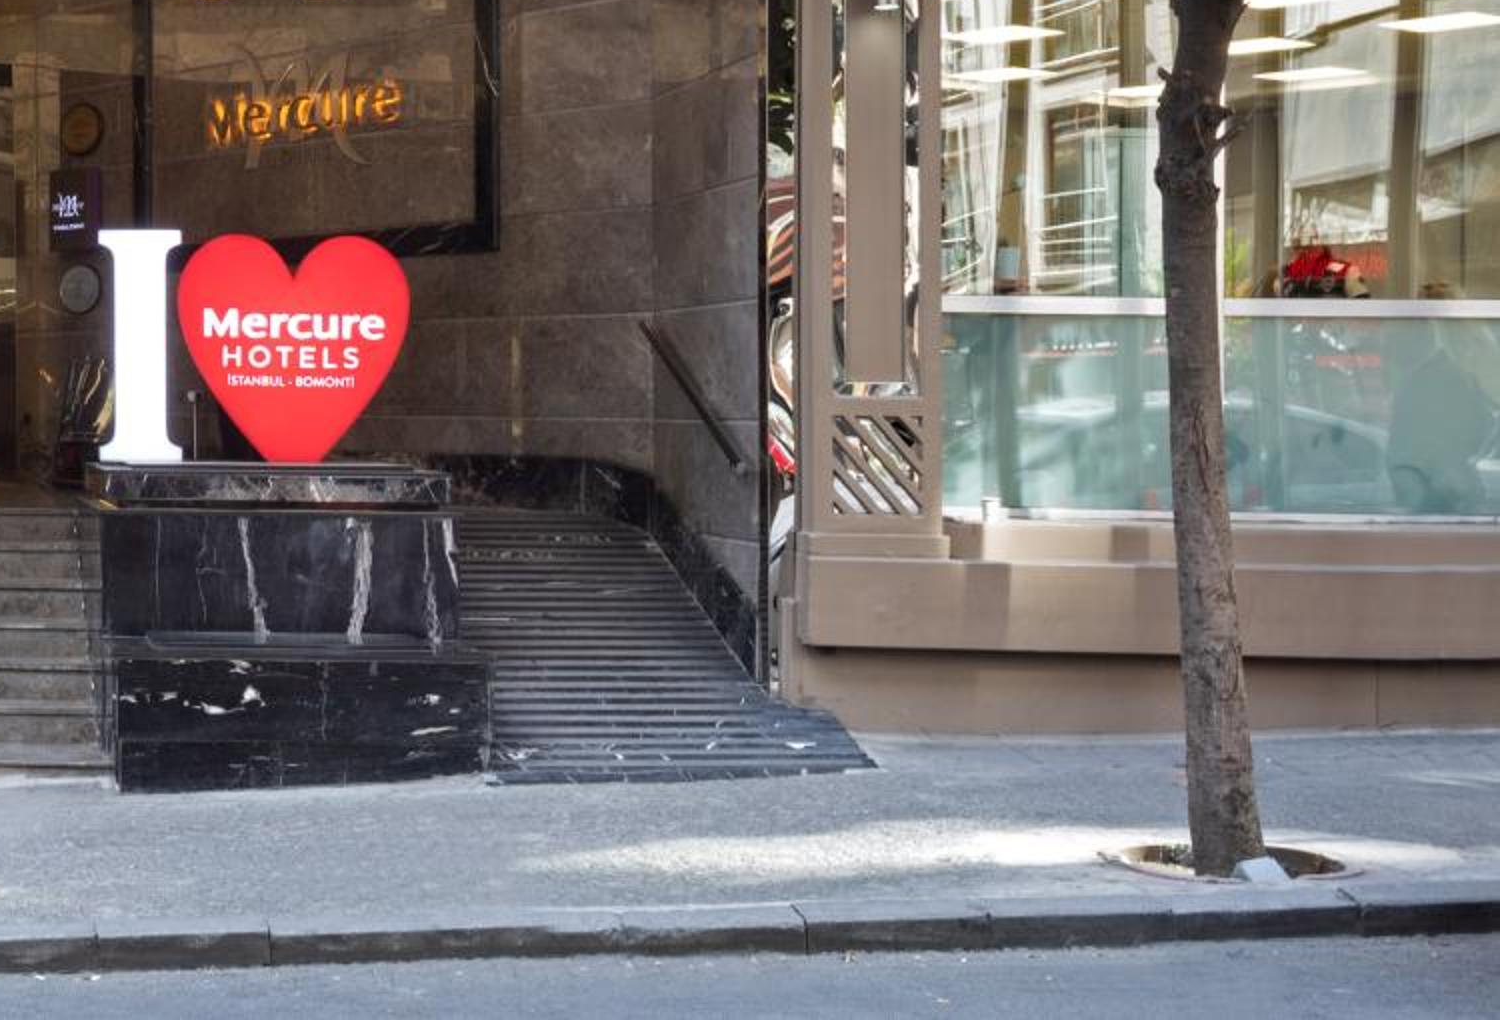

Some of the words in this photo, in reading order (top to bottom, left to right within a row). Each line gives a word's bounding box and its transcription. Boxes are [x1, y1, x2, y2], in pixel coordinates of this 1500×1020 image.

[209, 80, 403, 148] Mercure
[97, 228, 183, 463] I
[203, 307, 386, 341] Mercure
[221, 344, 360, 370] HOTELS
